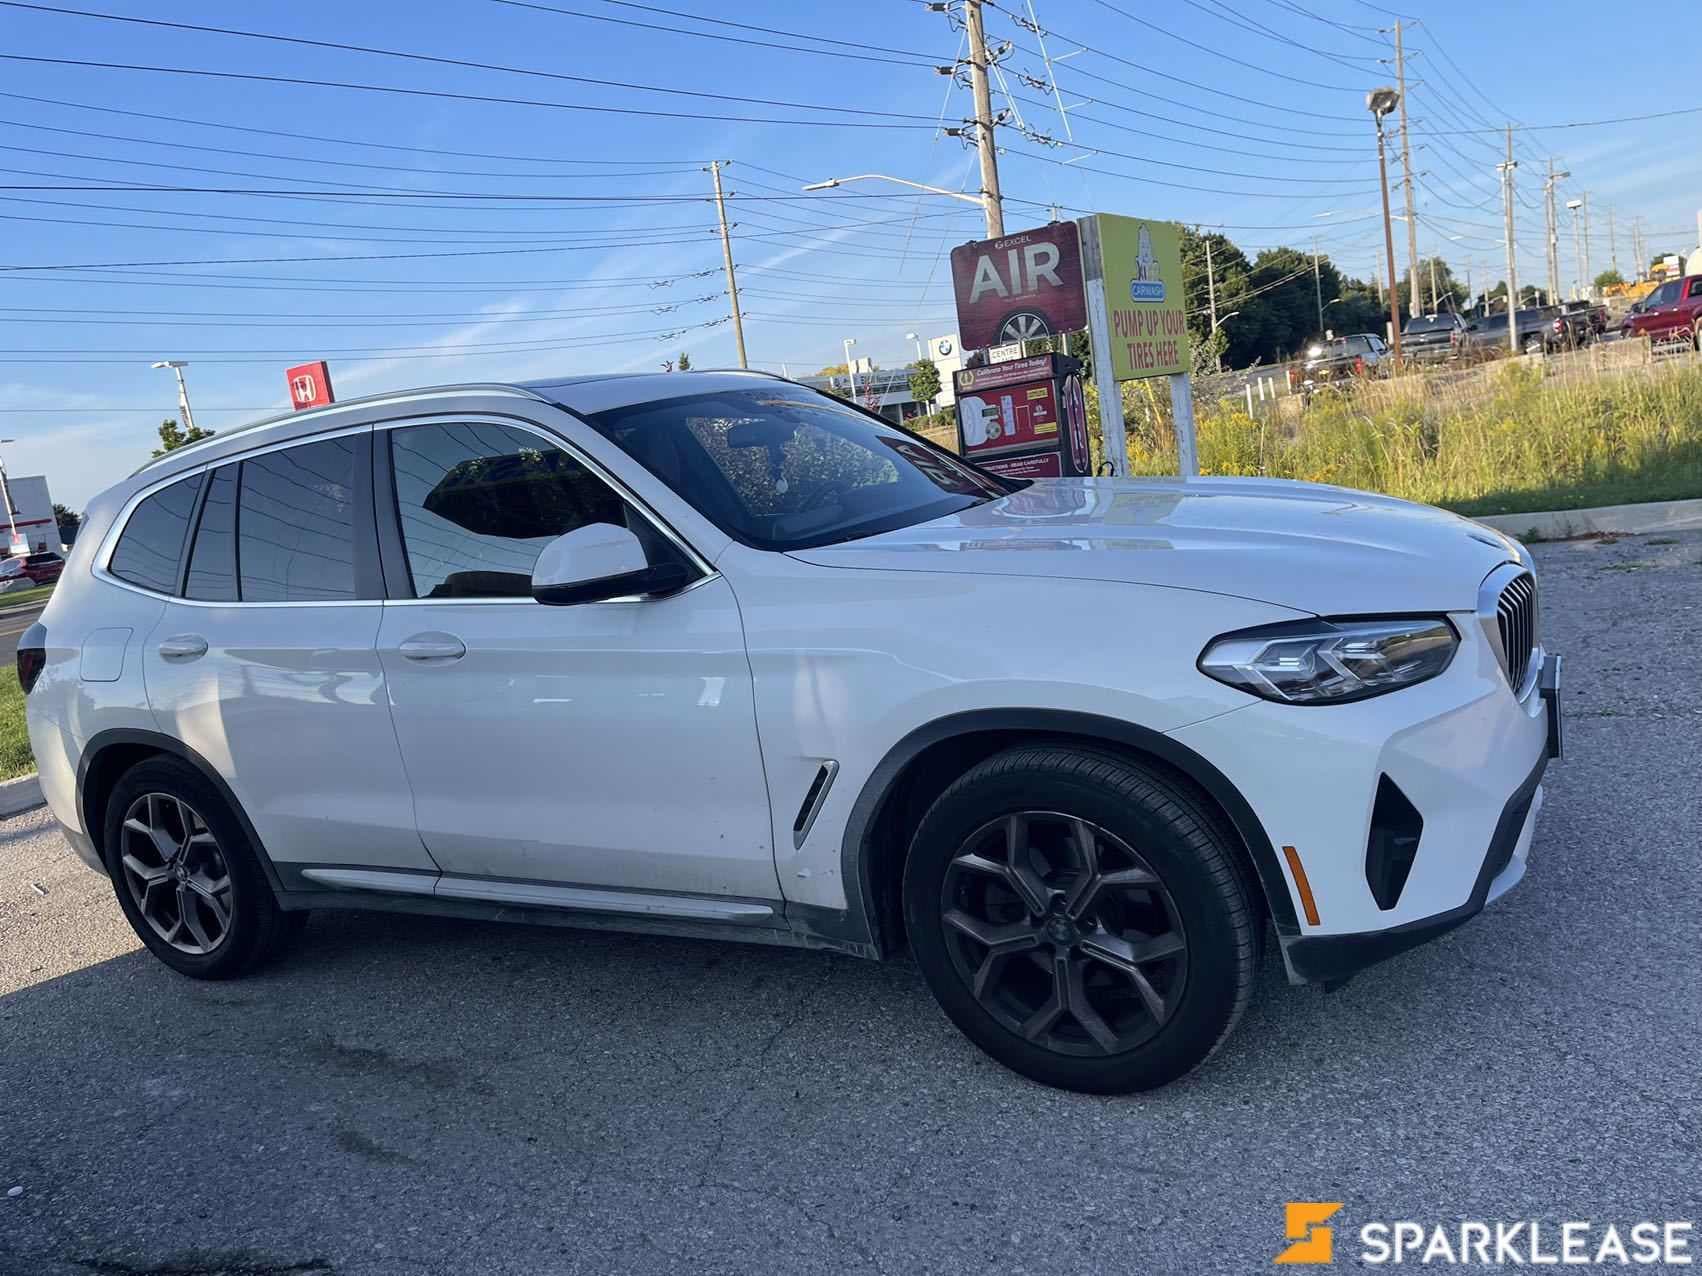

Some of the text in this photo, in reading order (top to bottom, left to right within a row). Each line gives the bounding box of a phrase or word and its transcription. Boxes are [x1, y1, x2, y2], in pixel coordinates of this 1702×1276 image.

[969, 241, 1064, 305] AIR
[1113, 309, 1185, 338] PUMP UP YOUR
[1127, 340, 1179, 370] TIRES HERE
